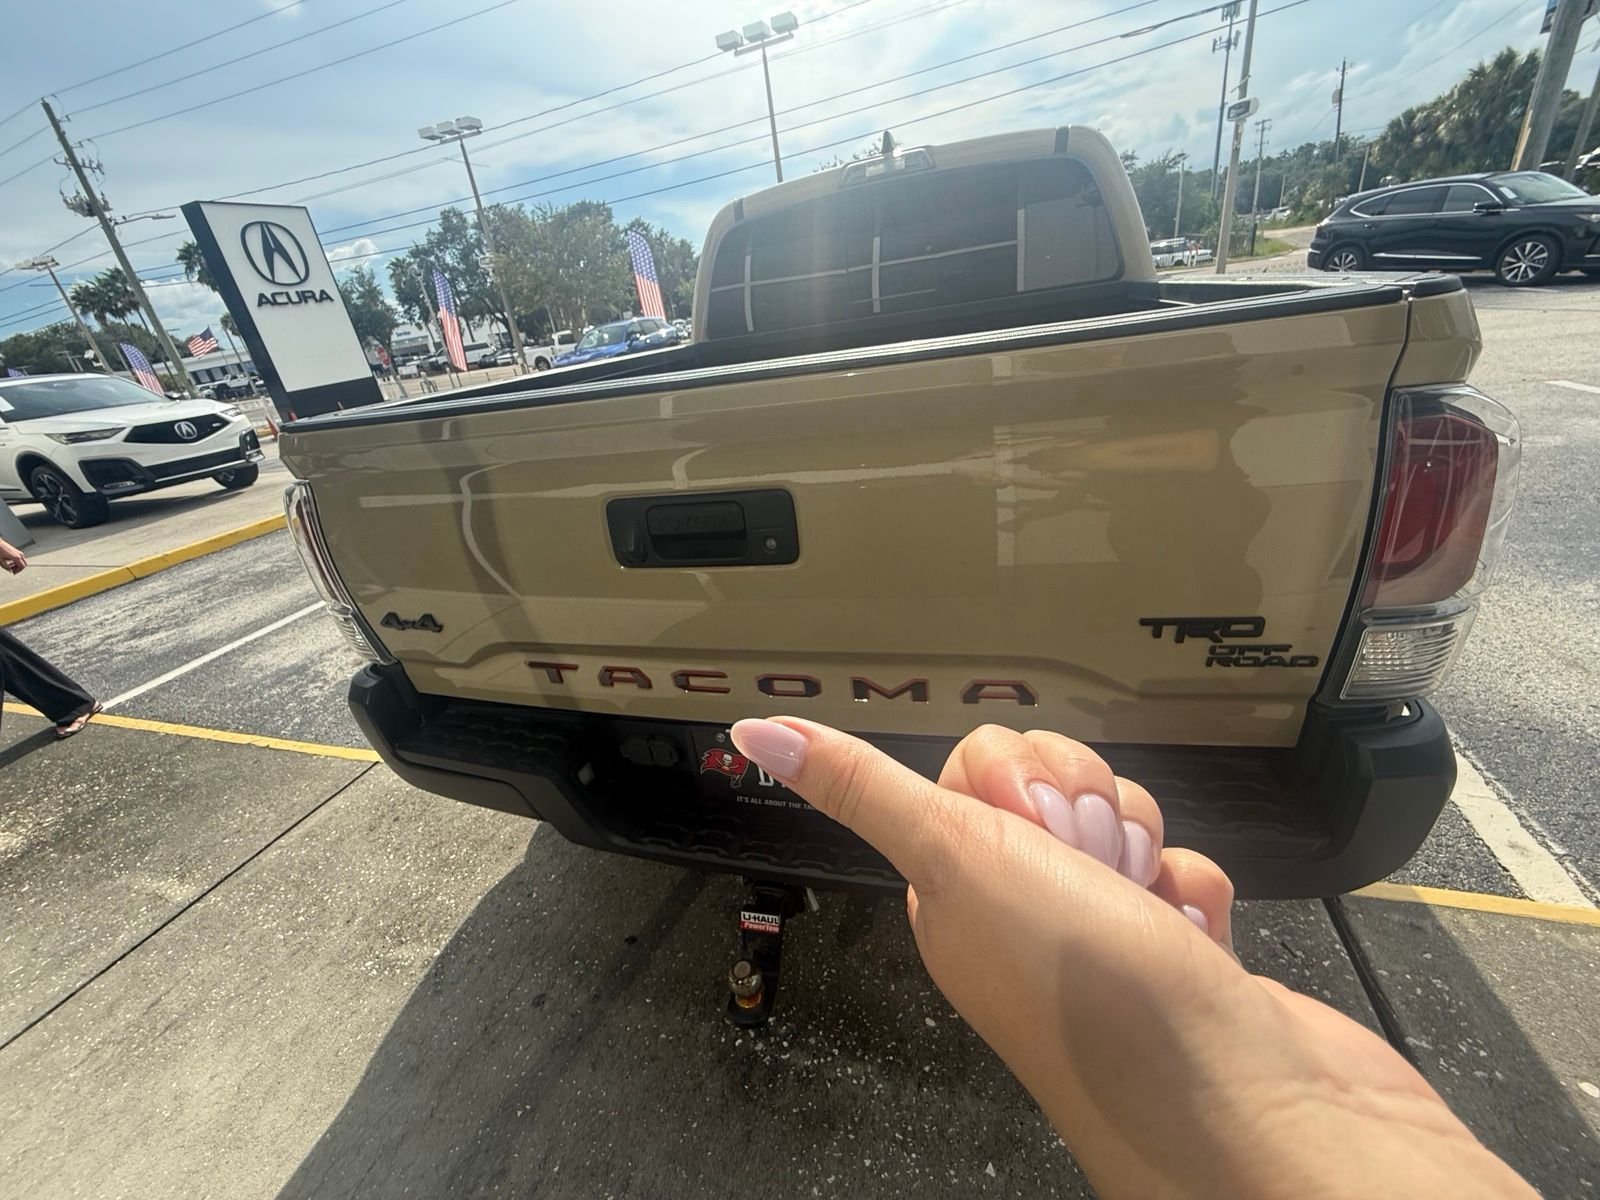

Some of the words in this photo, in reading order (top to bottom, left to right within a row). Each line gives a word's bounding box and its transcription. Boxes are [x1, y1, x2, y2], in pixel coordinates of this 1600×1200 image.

[257, 289, 335, 307] ACURA
[1139, 616, 1266, 643] TRD
[1209, 644, 1293, 656] OFF
[1205, 655, 1320, 667] ROAD
[525, 659, 1038, 706] TACOMA
[750, 797, 762, 805] ALL
[764, 799, 787, 807] ABOUT
[743, 913, 779, 924] U-HAUL
